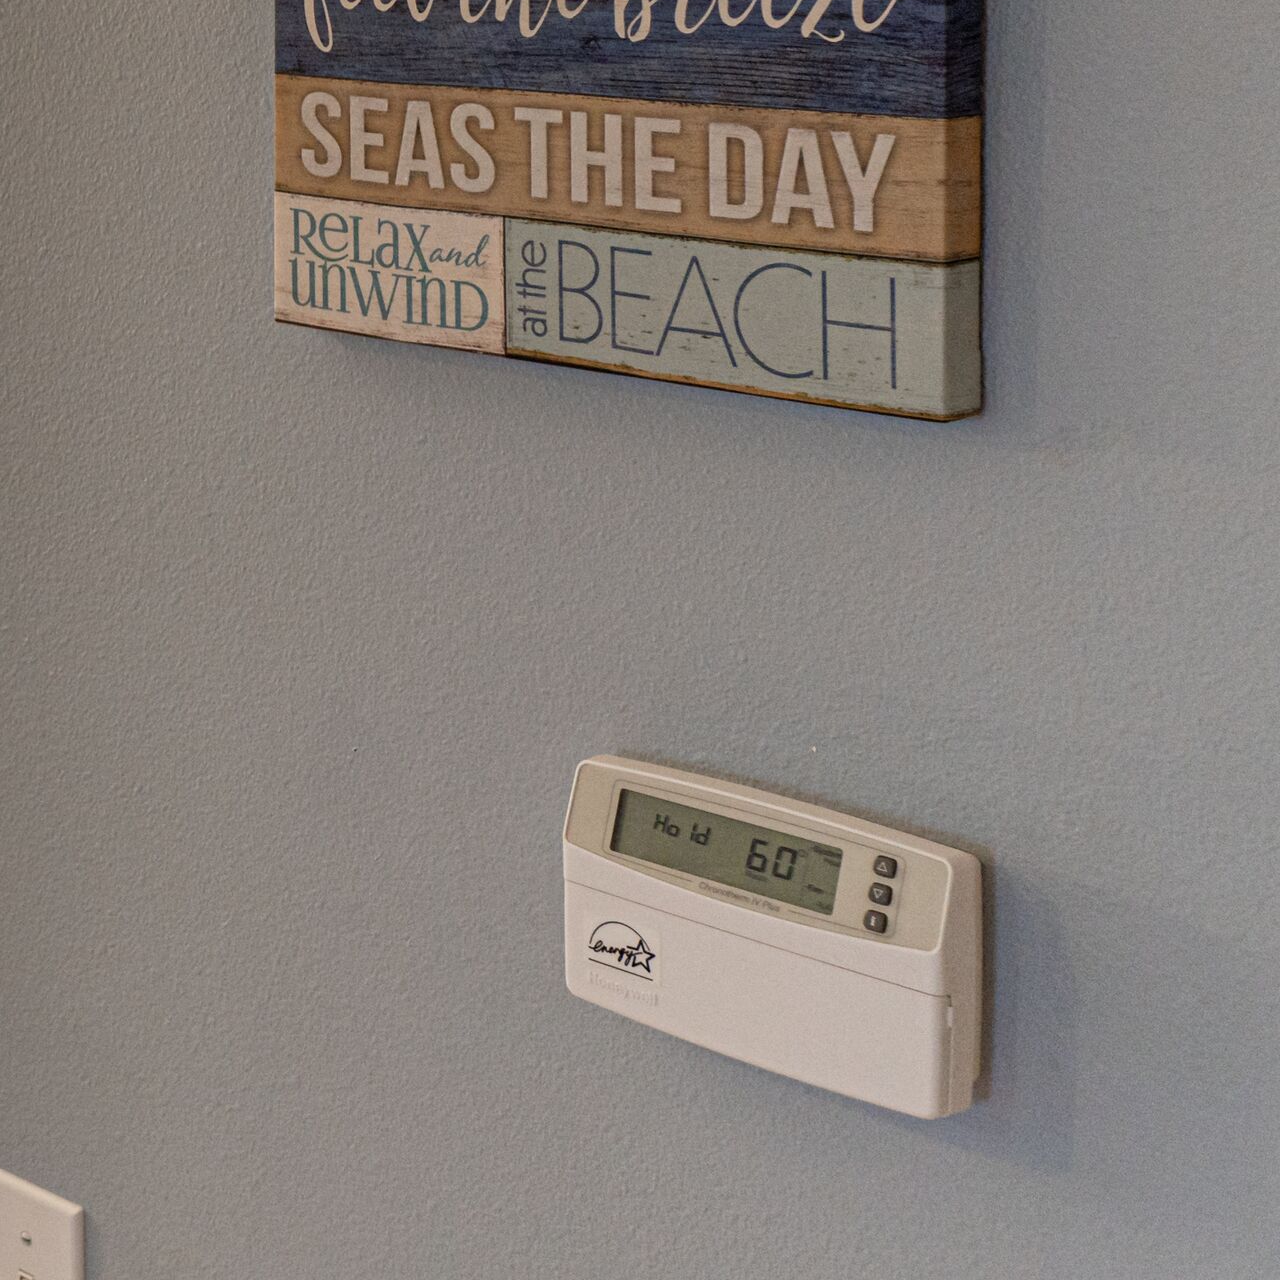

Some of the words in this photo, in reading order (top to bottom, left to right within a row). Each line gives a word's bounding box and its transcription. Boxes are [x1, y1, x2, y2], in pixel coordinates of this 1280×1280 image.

[300, 91, 495, 195] SEAS
[514, 107, 683, 214] THE
[707, 121, 897, 233] DAY
[429, 234, 490, 268] and
[515, 239, 548, 299] the
[516, 304, 548, 337] at
[557, 239, 898, 390] BEACH
